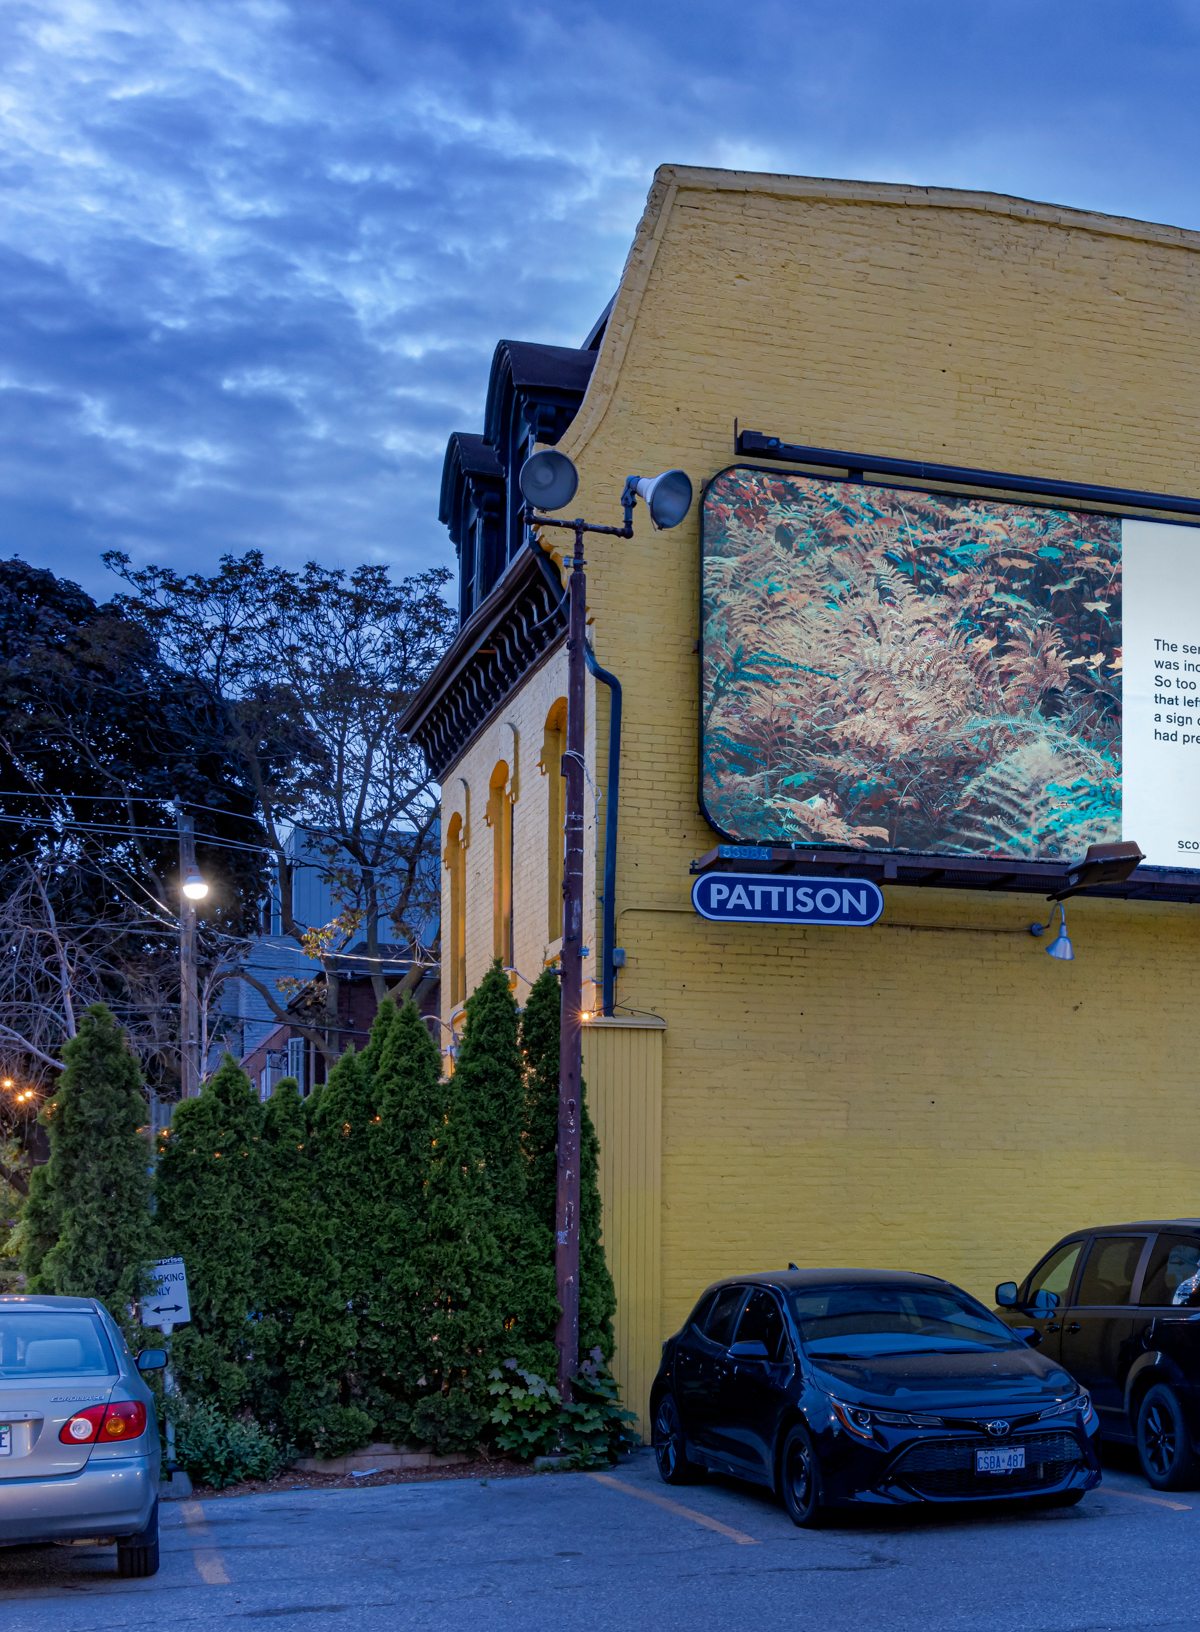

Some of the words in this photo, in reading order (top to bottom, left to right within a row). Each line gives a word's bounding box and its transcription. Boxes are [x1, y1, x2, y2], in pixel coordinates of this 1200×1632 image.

[1154, 639, 1178, 652] The
[1154, 659, 1180, 670] was
[1154, 675, 1172, 688] So
[1176, 678, 1197, 690] too
[1154, 694, 1179, 706] that
[1153, 712, 1162, 722] a
[1166, 712, 1193, 727] sign
[1154, 728, 1178, 742] had
[710, 883, 867, 915] PATTISON
[152, 1272, 185, 1283] ARKING
[977, 1455, 1002, 1470] CSBA
[1006, 1453, 1025, 1468] 487
